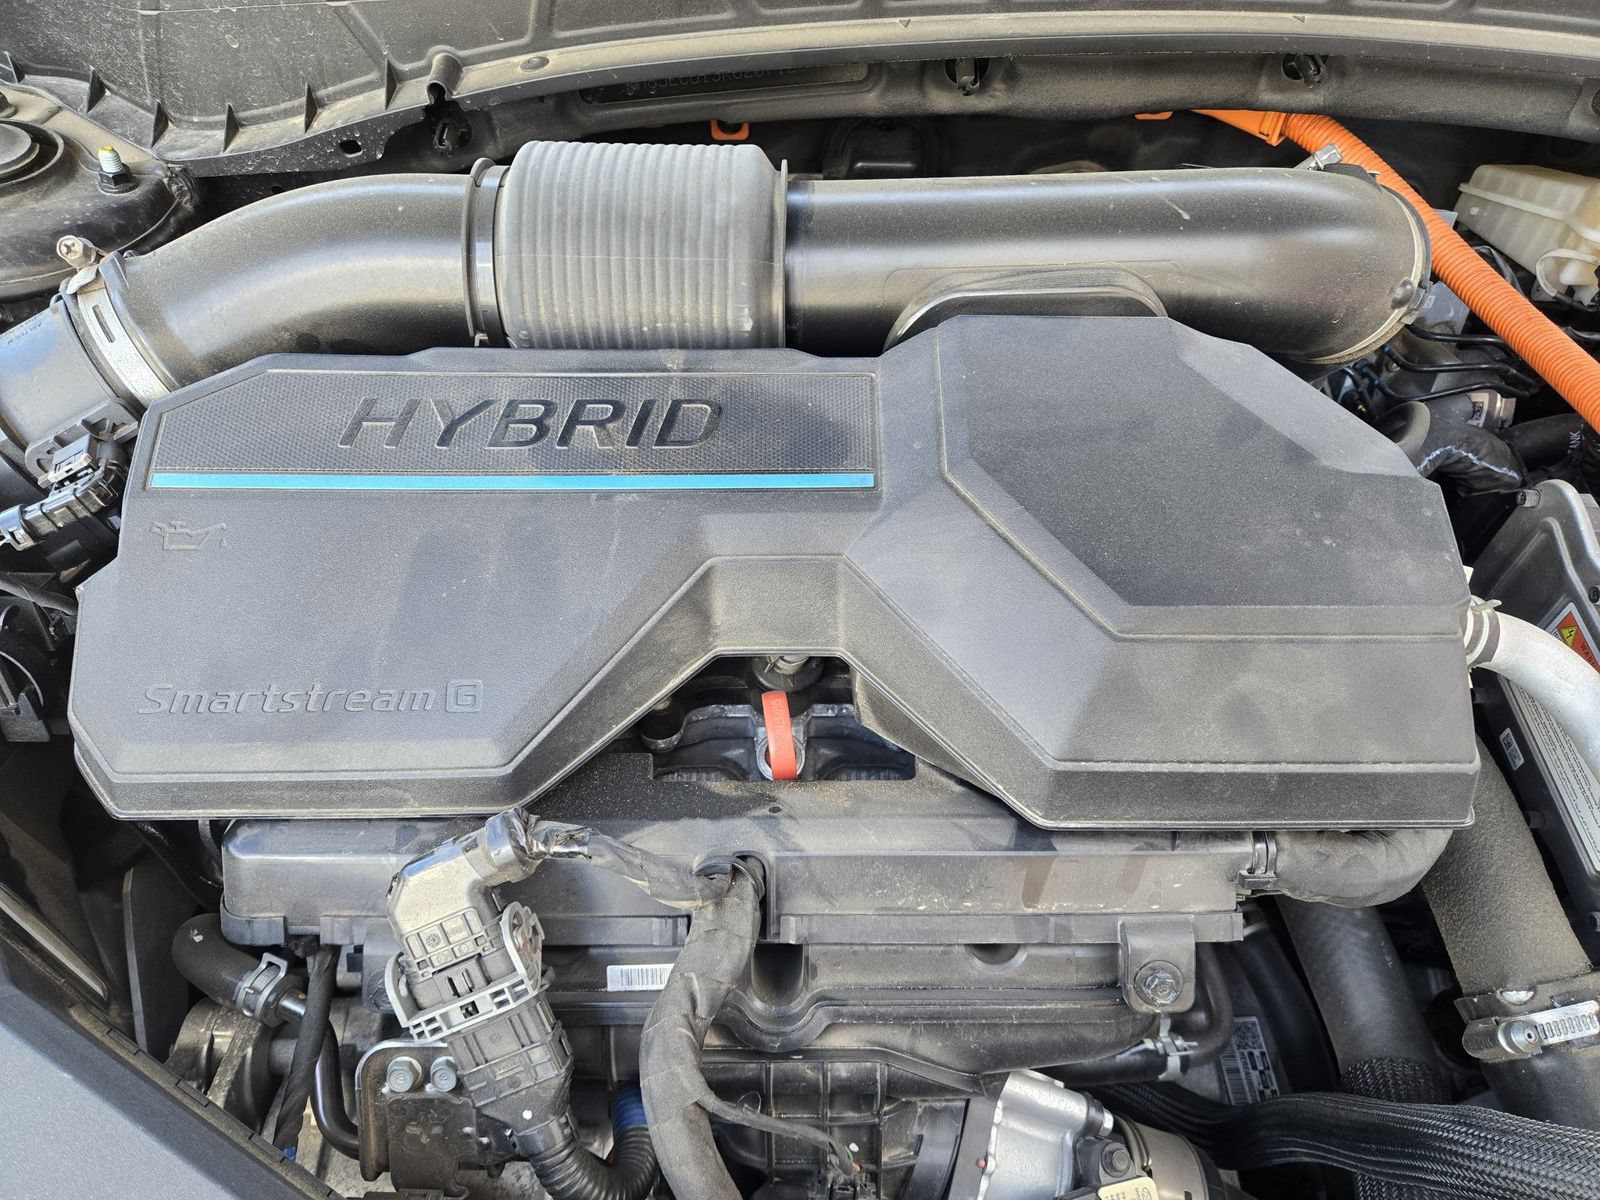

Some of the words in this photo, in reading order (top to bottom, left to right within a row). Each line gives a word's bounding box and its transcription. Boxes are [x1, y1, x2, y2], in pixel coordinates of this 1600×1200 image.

[337, 398, 723, 449] HYBRID
[137, 683, 436, 714] Smartstream
[451, 682, 480, 710] G
